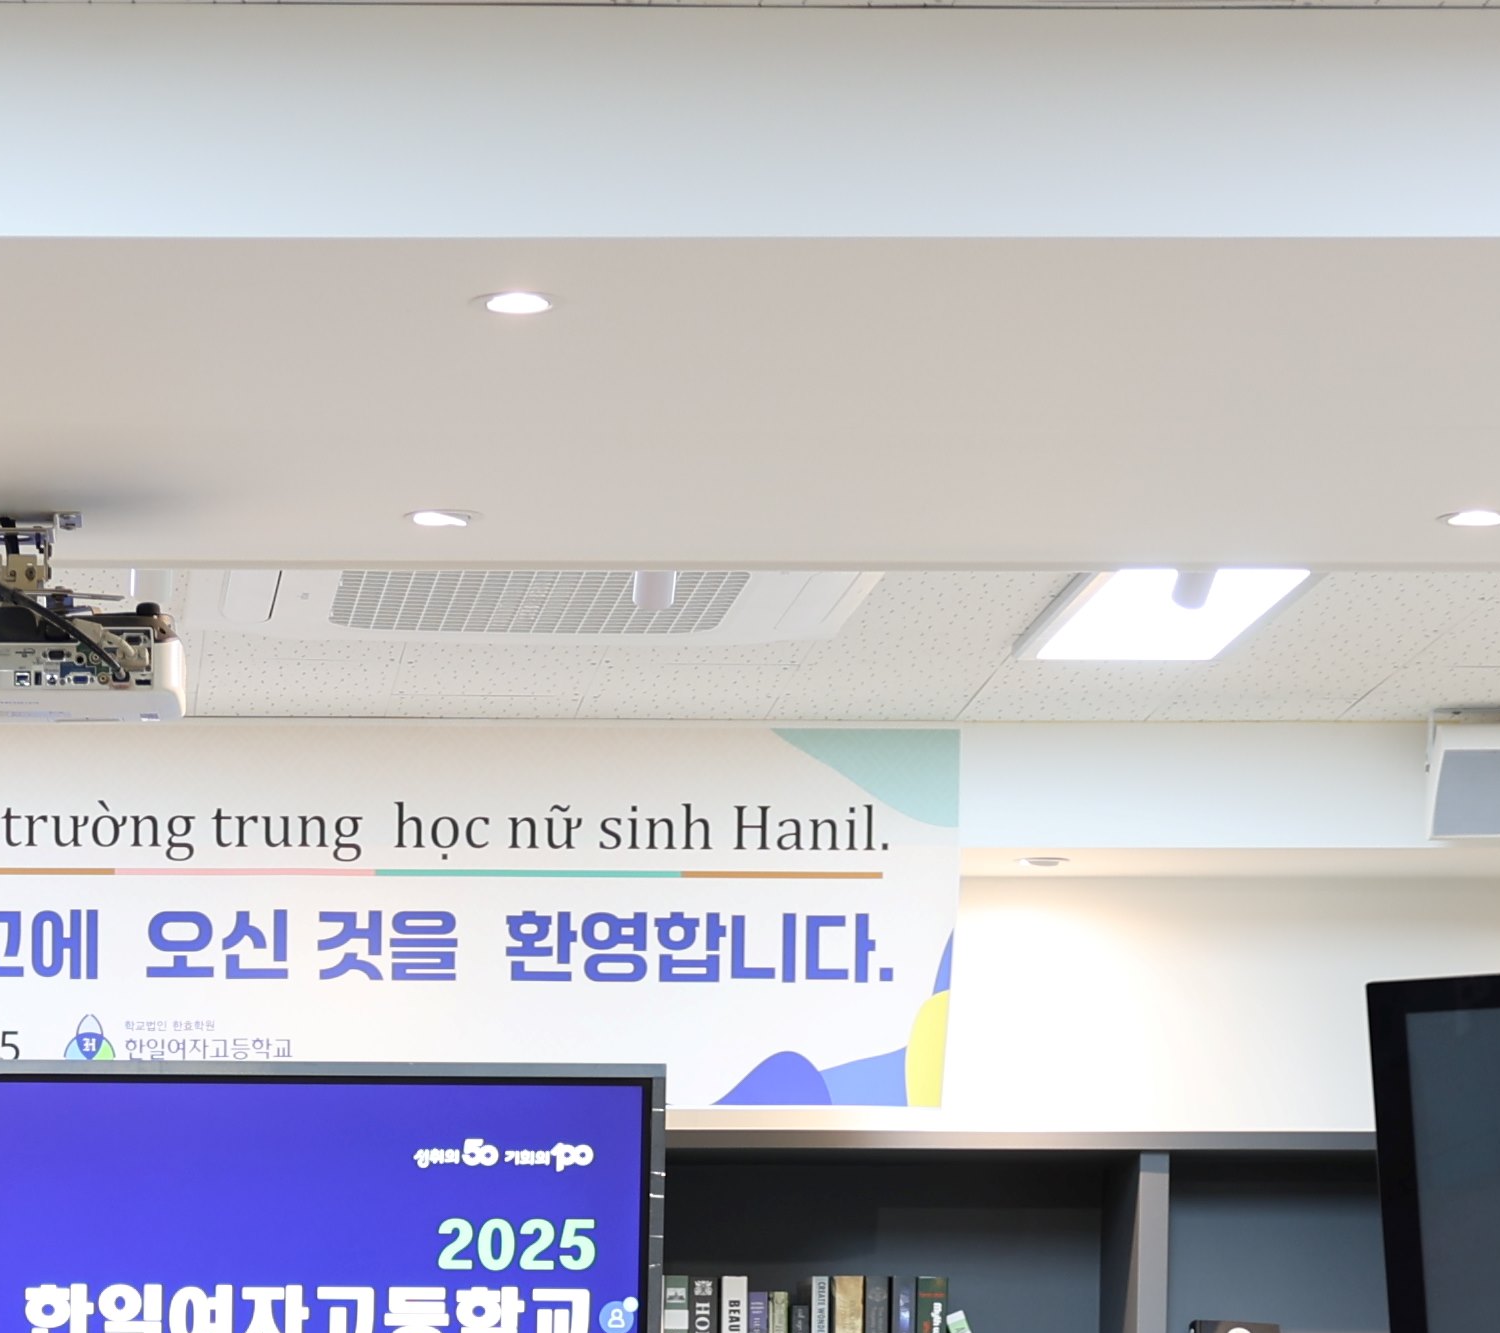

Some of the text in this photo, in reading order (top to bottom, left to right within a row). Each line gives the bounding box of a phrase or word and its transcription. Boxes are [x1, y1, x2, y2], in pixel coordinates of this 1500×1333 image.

[1, 800, 195, 862] trường
[211, 809, 363, 862] trung
[393, 800, 490, 860] học
[507, 800, 583, 851] nữ
[598, 801, 713, 852] sinh
[731, 803, 891, 853] Hanil.
[145, 908, 292, 982] 오신
[315, 909, 460, 982] 것을
[503, 909, 896, 983] 환영합니다.
[125, 1037, 293, 1061] 한일여자고등학교
[437, 1217, 597, 1272] 2025
[817, 1281, 827, 1306] CREATE
